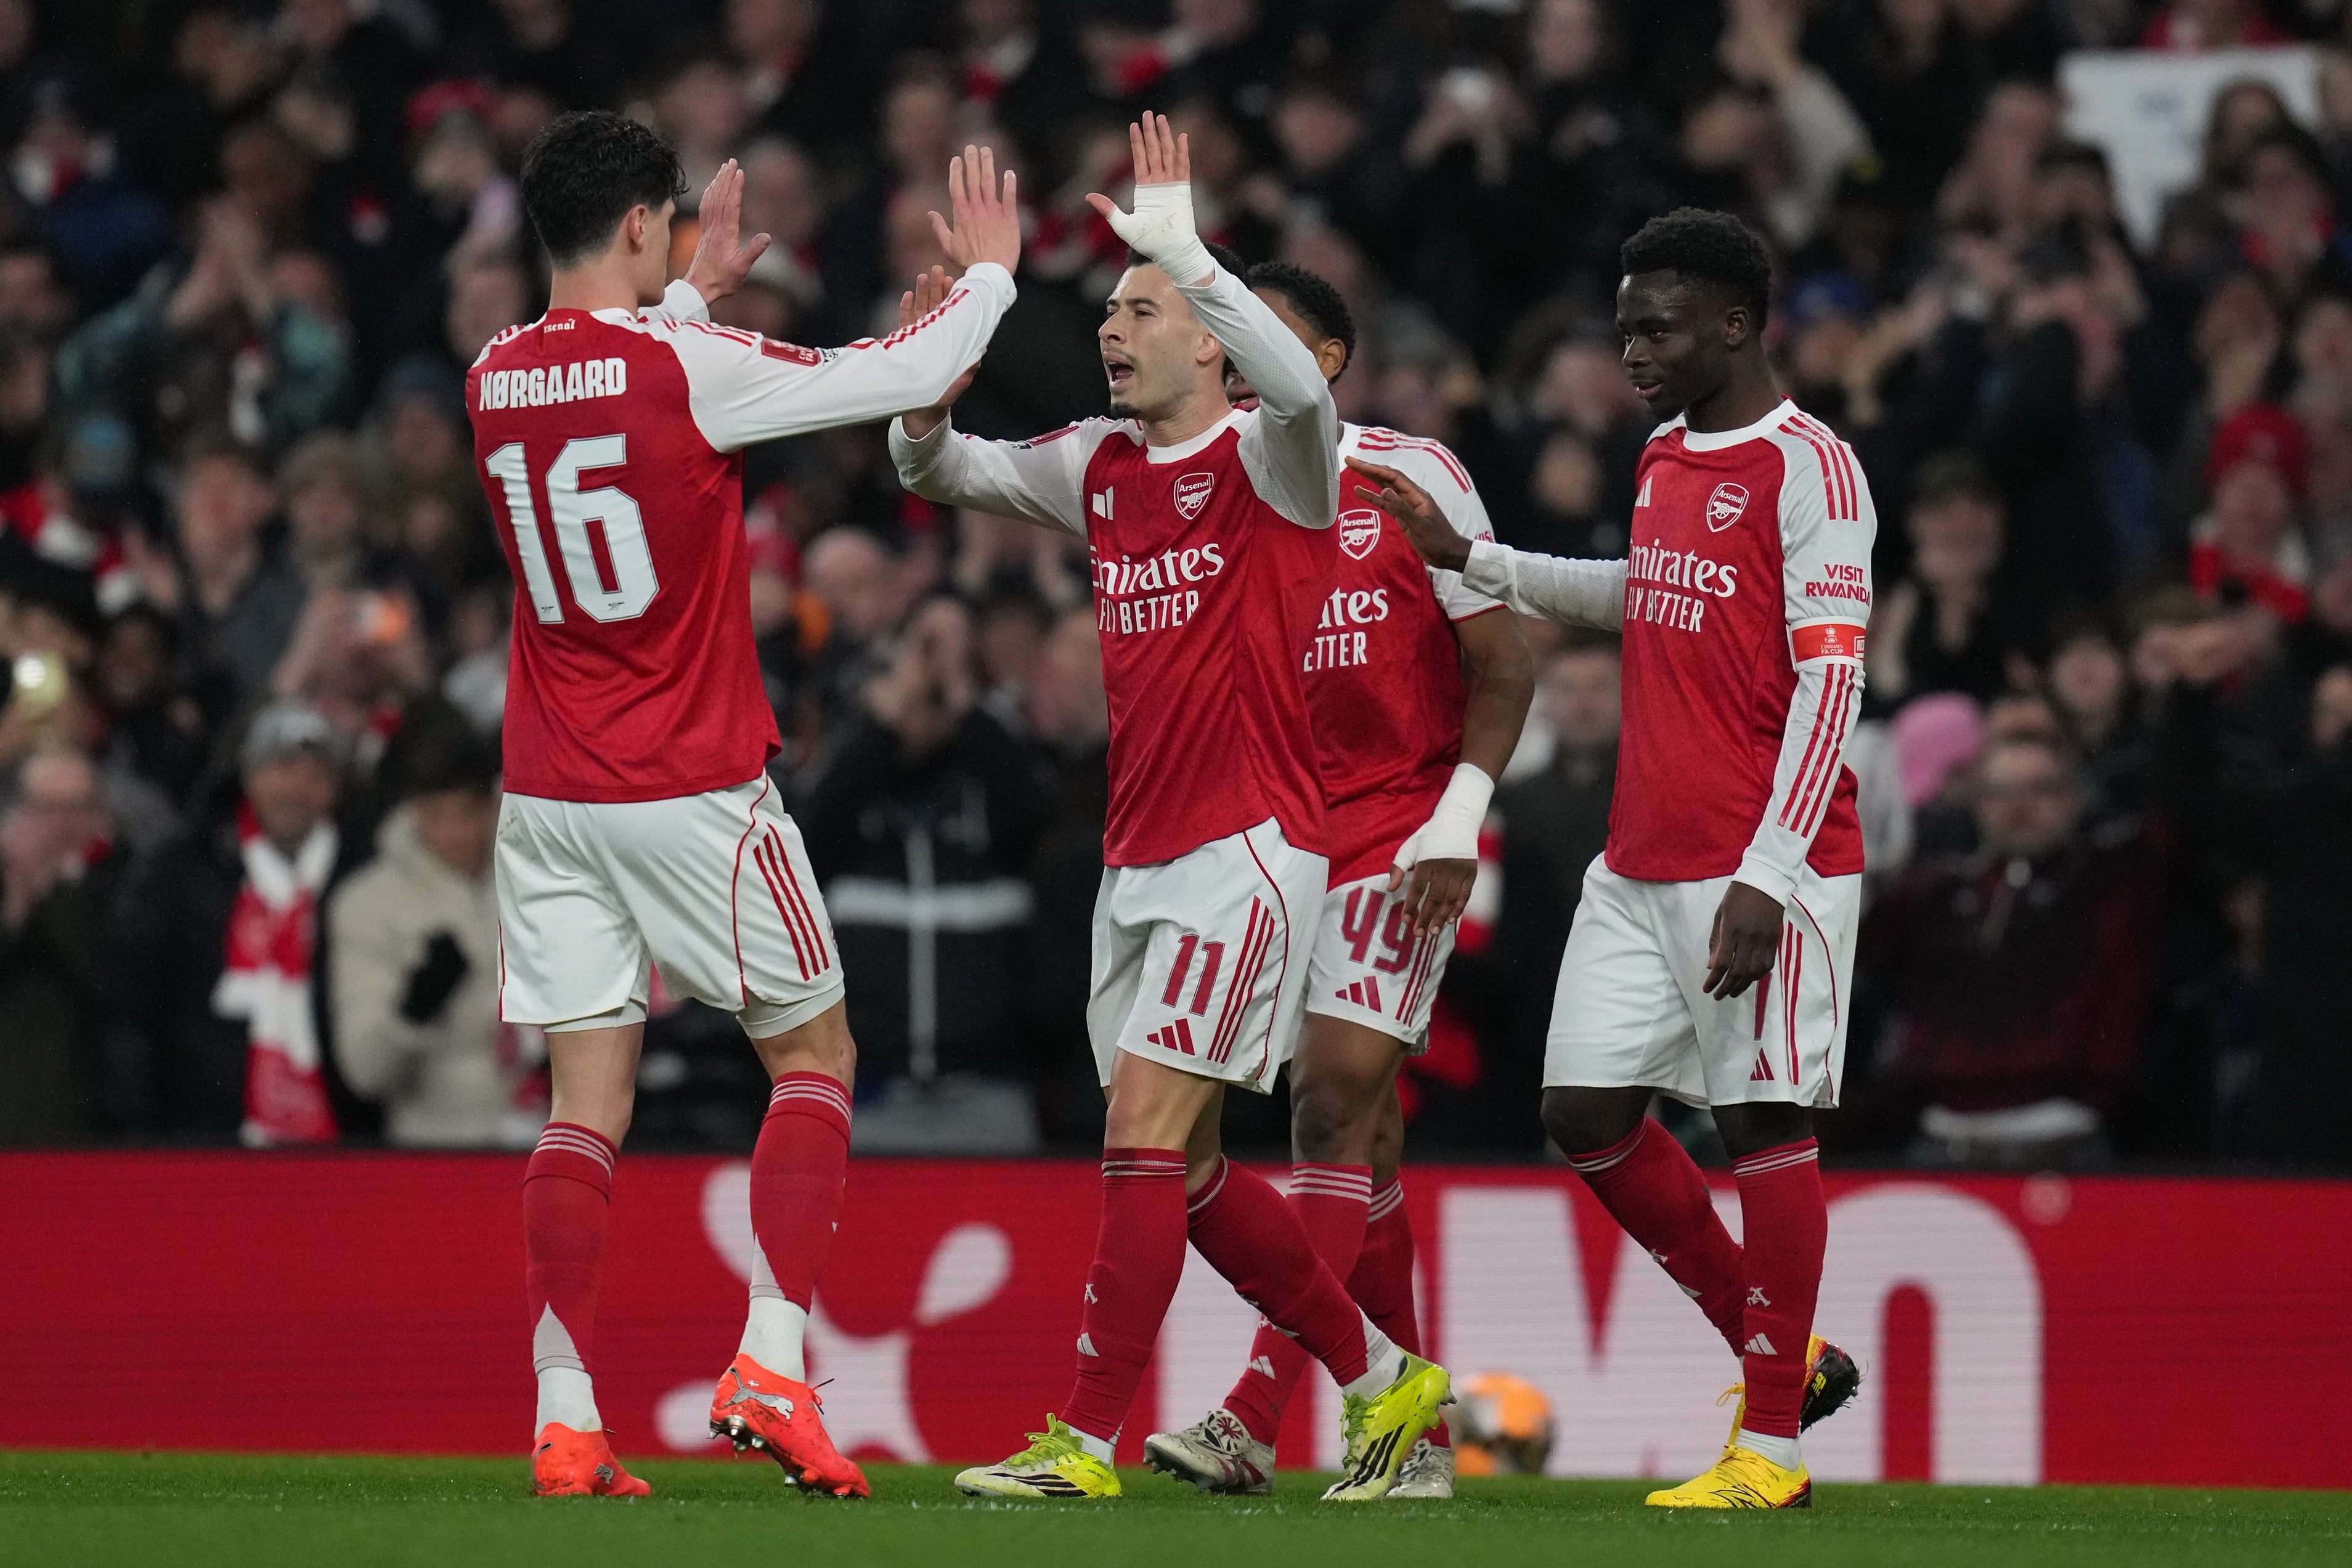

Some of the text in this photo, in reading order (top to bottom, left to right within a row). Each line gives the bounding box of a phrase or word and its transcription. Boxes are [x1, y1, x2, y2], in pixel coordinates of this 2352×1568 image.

[543, 318, 576, 333] rsenal
[479, 357, 627, 411] NØRGAARD
[1179, 479, 1209, 493] Arsenal
[1717, 489, 1744, 504] Arsenal
[485, 433, 660, 624] 16
[1342, 516, 1374, 527] Arsenal
[1824, 564, 1864, 583] VISIT
[1119, 590, 1199, 635] BETTER
[1627, 587, 1704, 633] FLY BETTER
[1341, 885, 1417, 976] 49
[1160, 933, 1226, 1017] 11
